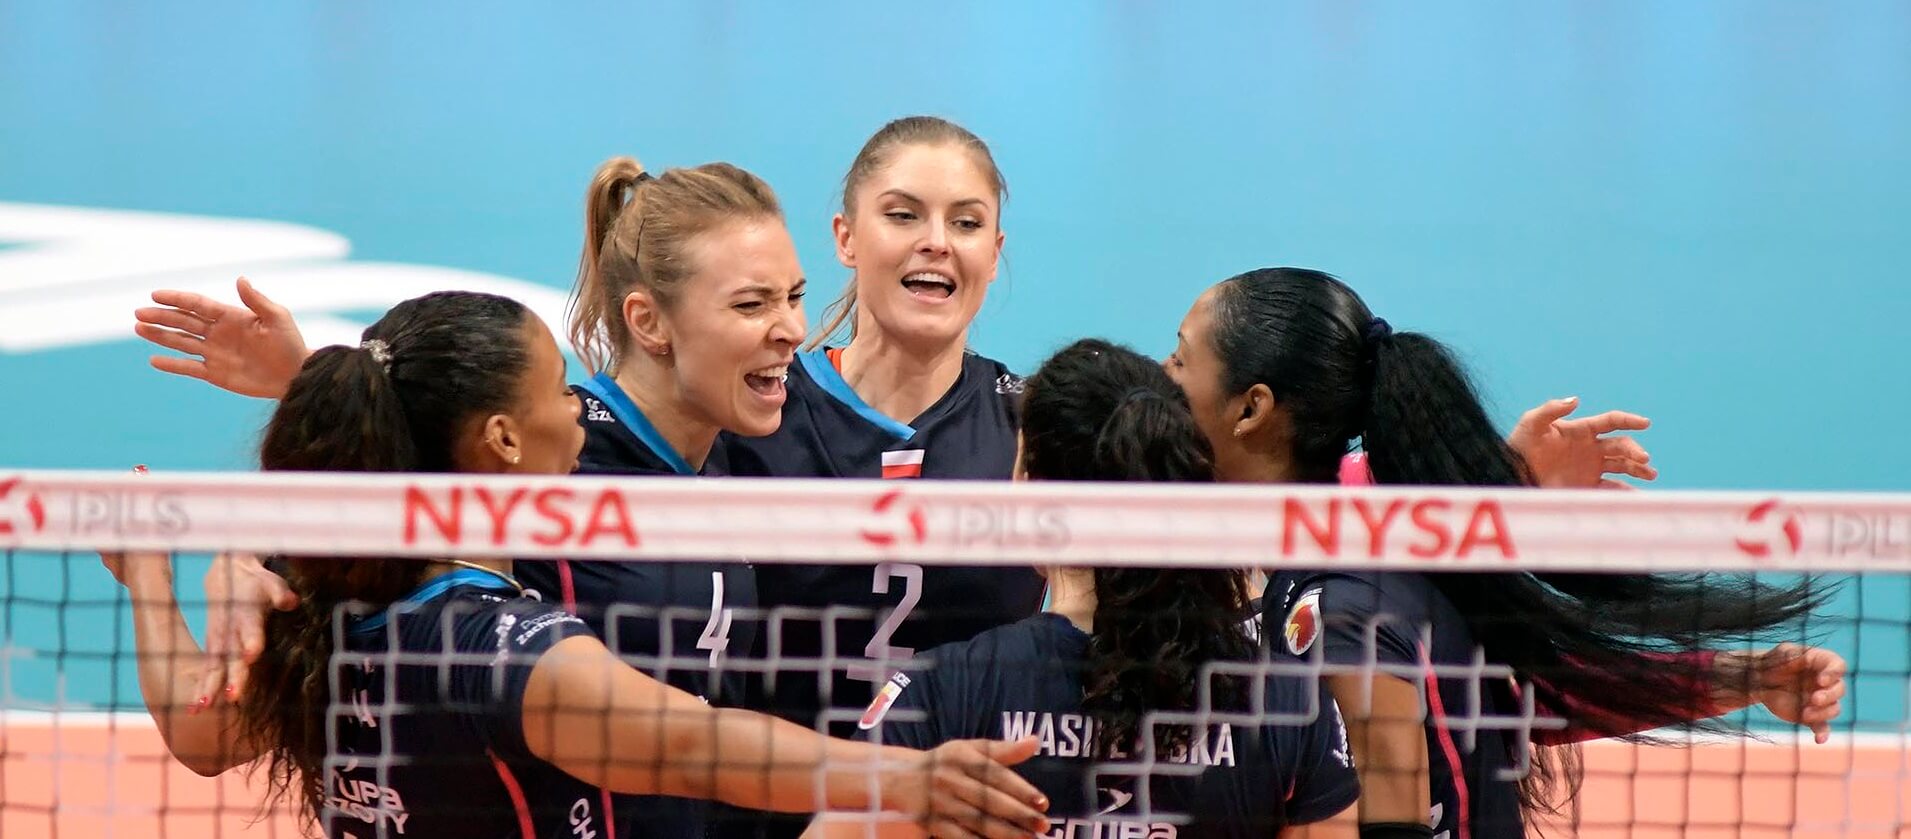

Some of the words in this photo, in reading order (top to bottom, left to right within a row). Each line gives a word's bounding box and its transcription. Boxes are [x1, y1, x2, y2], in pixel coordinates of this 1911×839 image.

[403, 486, 640, 547] NYSA
[1281, 496, 1518, 558] NYSA
[696, 572, 733, 668] 4
[864, 562, 923, 660] 2
